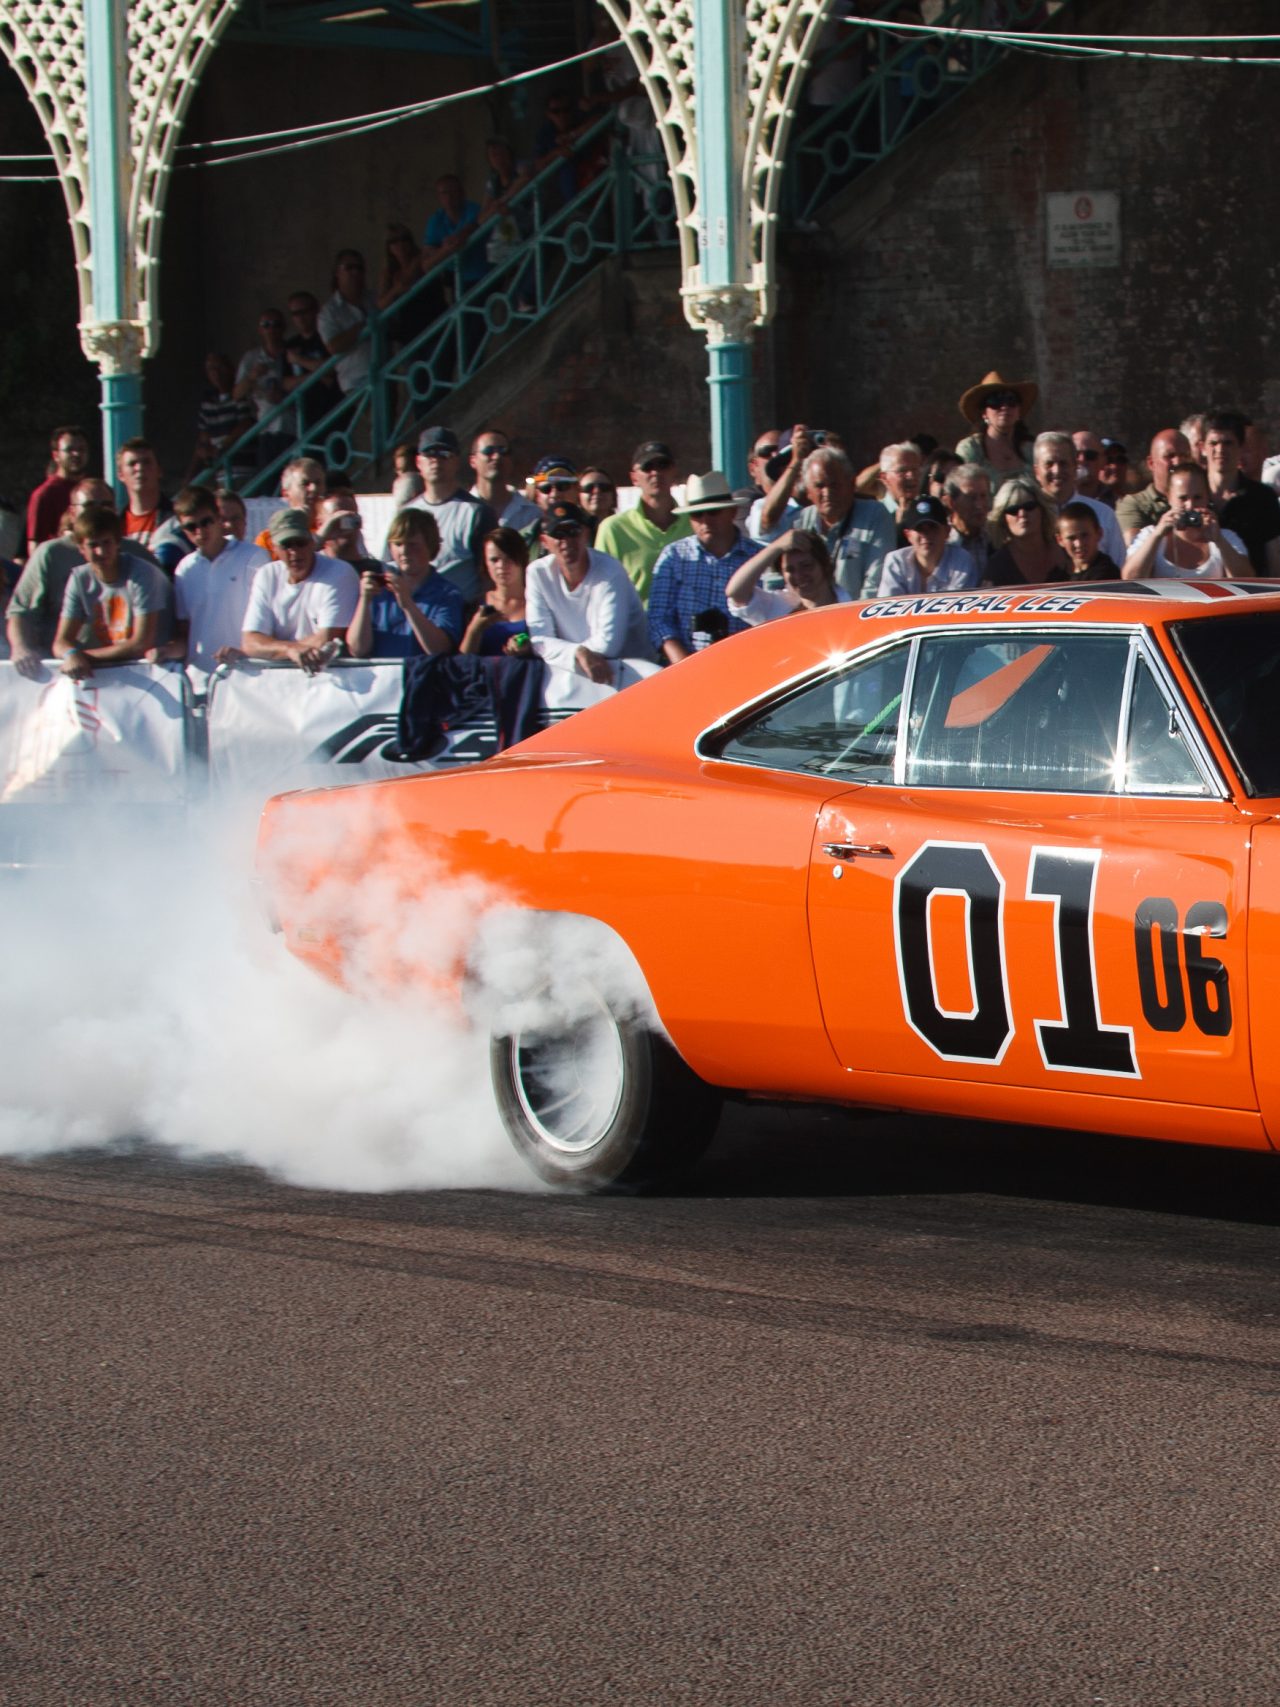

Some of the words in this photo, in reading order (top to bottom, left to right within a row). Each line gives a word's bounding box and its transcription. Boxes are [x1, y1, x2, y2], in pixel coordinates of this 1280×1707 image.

[860, 595, 1015, 620] GENERAL
[1014, 595, 1094, 615] LEE
[893, 839, 1142, 1080] 01
[1134, 897, 1232, 1037] 06
